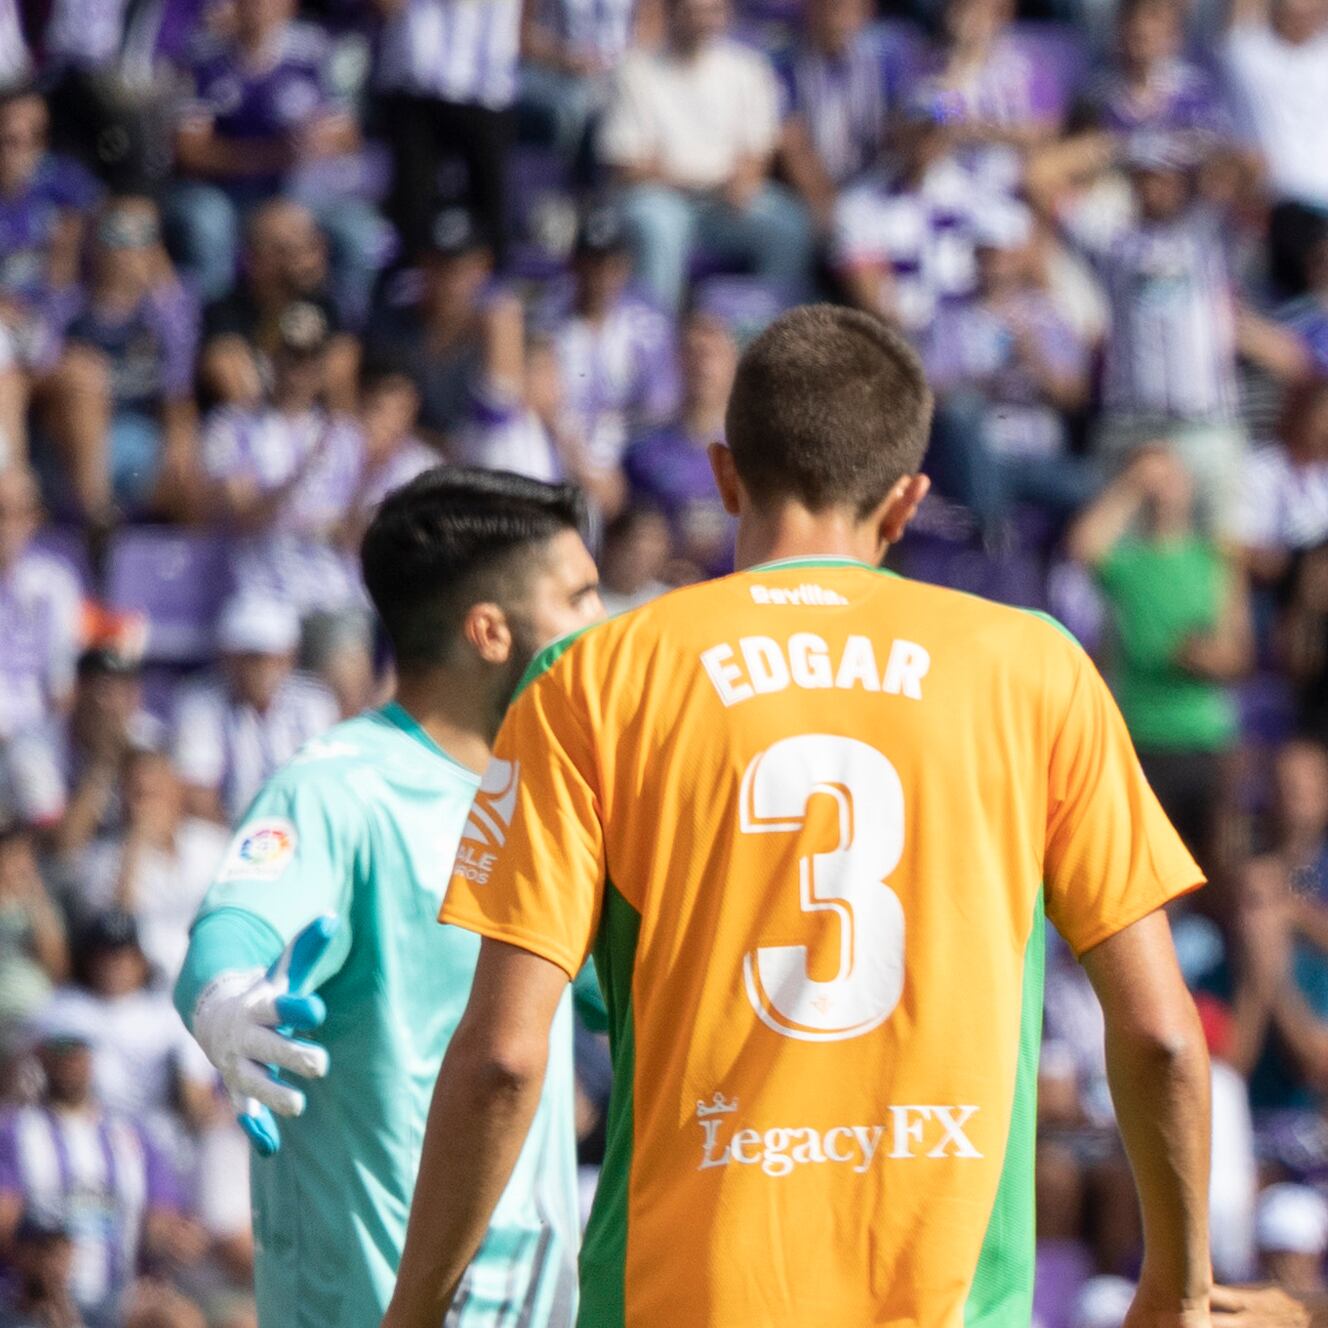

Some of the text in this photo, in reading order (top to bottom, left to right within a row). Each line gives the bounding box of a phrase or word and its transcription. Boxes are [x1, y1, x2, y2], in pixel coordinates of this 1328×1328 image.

[699, 632, 931, 708] EDGAR
[739, 733, 906, 1042] 3
[697, 1102, 985, 1177] LegacyFX
